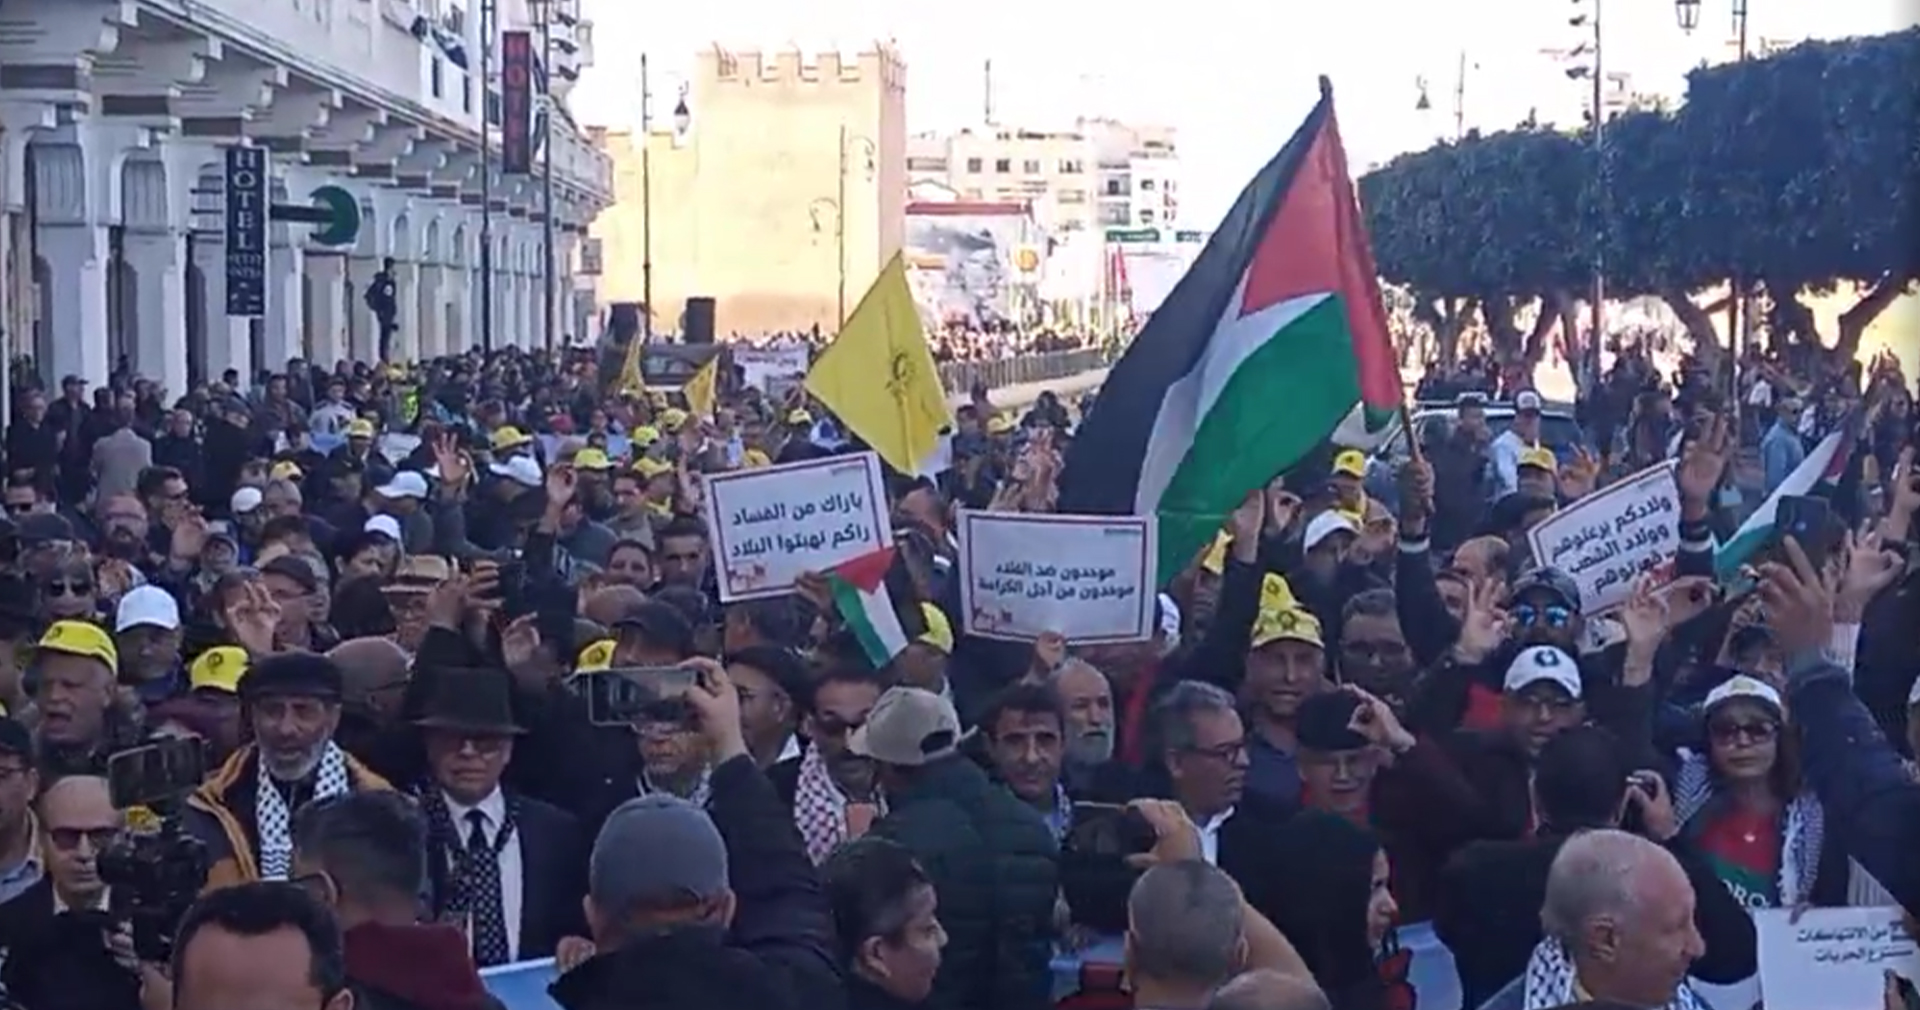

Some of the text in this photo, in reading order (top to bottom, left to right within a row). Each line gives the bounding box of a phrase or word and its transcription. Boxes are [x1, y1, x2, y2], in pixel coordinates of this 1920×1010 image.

[234, 151, 256, 249] HOTEL
[732, 492, 862, 525] باراك من الفساد
[731, 523, 870, 557] راكم نهبتوا البلاد
[996, 561, 1115, 582] موحدون ضد الغلاء
[1569, 540, 1621, 574] الشعب
[978, 576, 1135, 600] موحدون من أجل الكرامة
